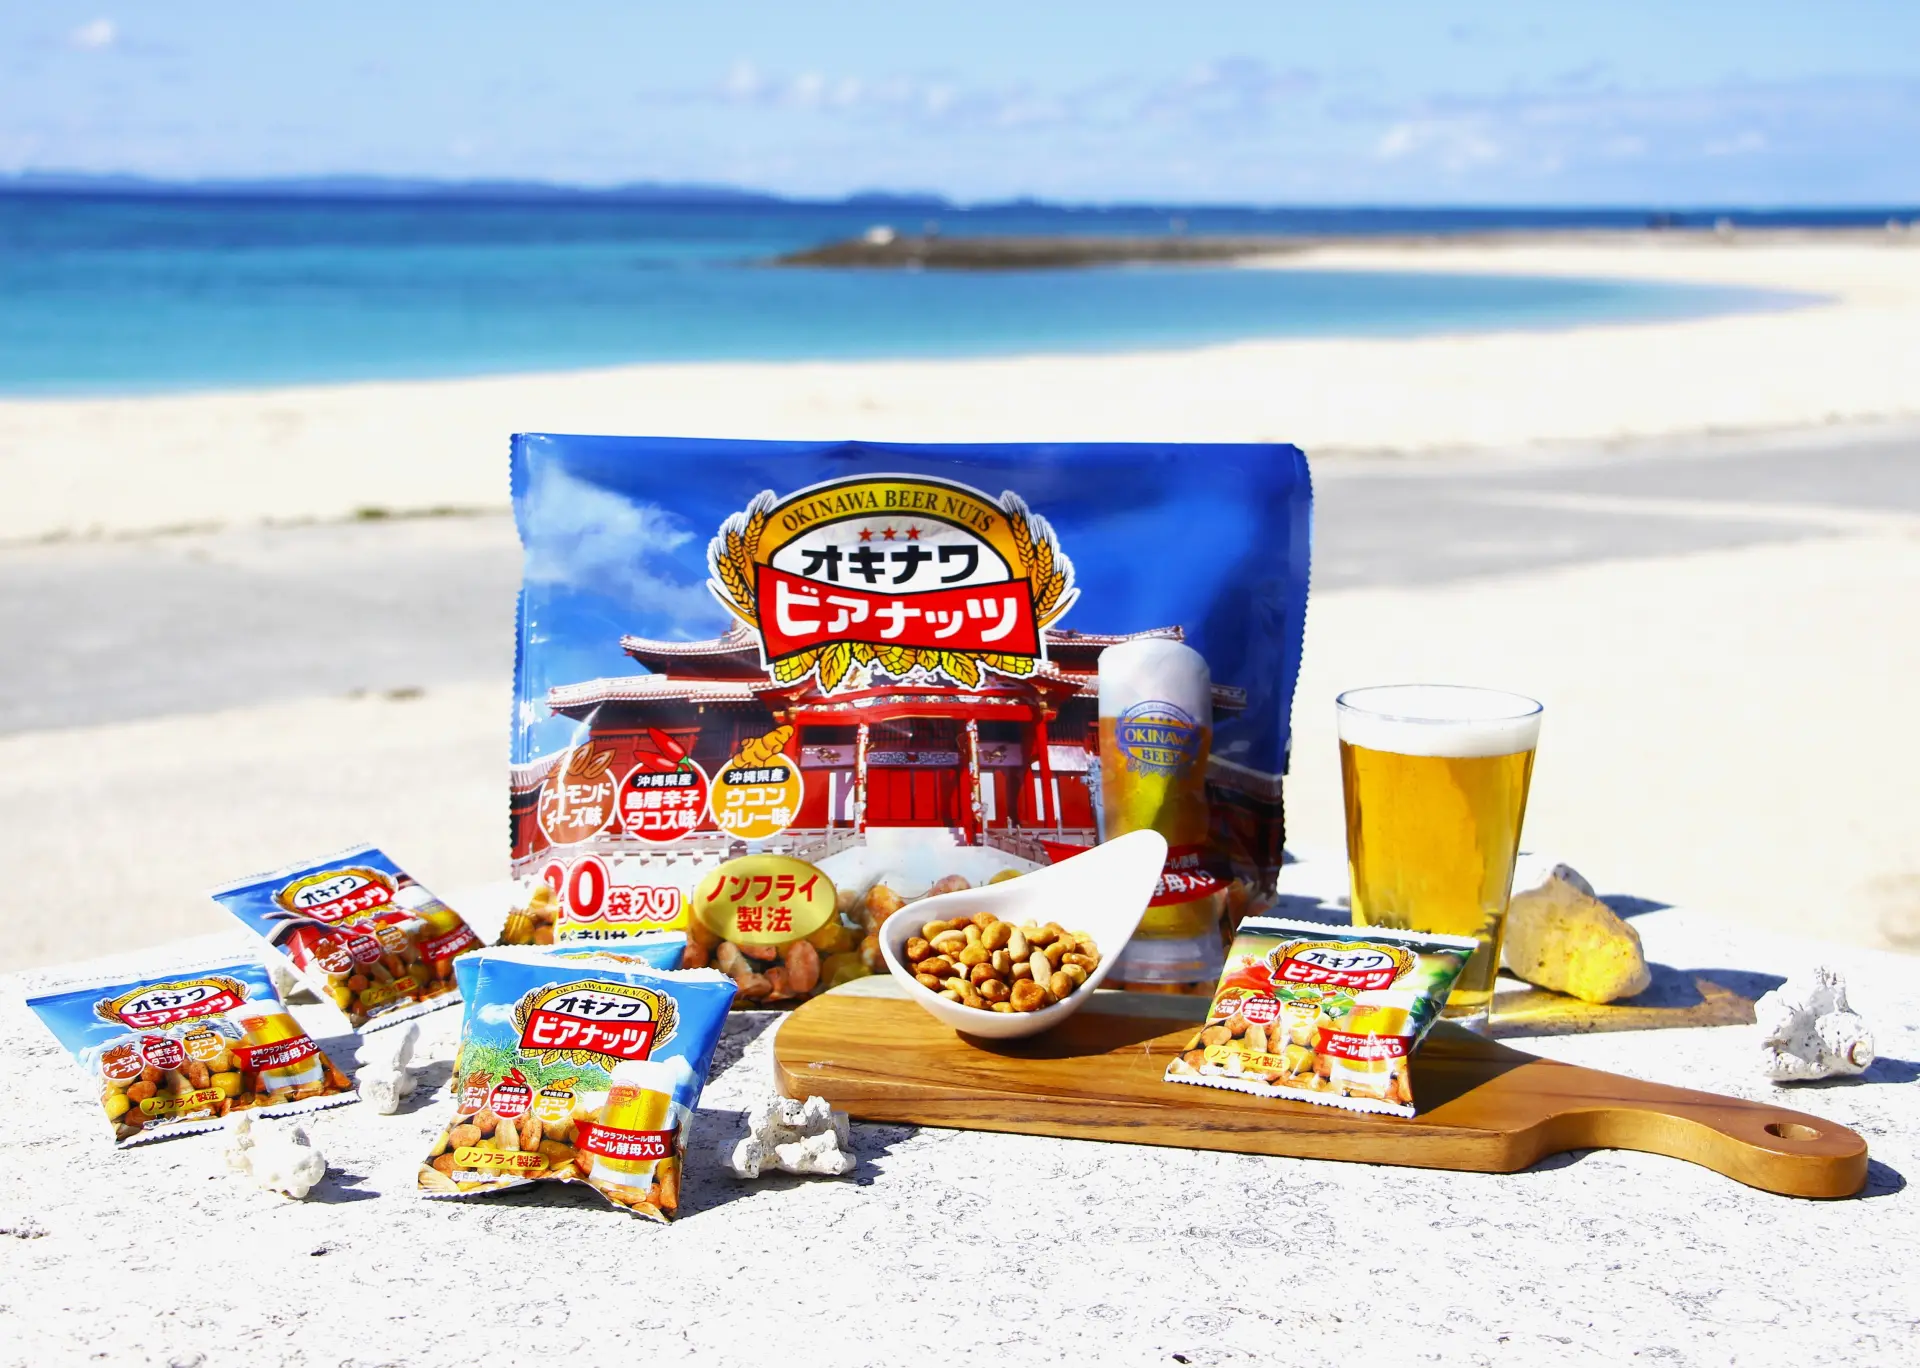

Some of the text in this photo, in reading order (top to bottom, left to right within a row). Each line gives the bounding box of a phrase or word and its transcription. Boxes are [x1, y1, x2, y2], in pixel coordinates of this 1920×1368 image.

[782, 489, 996, 533] OKINAWA BEER NUTS
[801, 544, 979, 584] オキナワ
[775, 580, 1018, 643] ビアナッツ
[636, 773, 693, 787] 沖縄県産
[728, 767, 785, 784] 沖縄県産
[624, 789, 701, 810] 島唐辛子
[725, 788, 786, 807] ウコン
[625, 809, 698, 831] タコス味
[718, 807, 791, 829] カレー味
[706, 873, 821, 902] ノンフライ
[735, 906, 793, 933] 製法
[1306, 952, 1385, 969] オキナワ
[1283, 963, 1391, 989] ビアナッツ
[556, 982, 602, 995] OKINAWA
[128, 995, 234, 1026] ビアナッツ
[131, 987, 206, 1013] オキナワ
[555, 996, 641, 1018] オキナワ
[530, 1015, 648, 1055] ビアナッツ
[587, 1135, 666, 1157] ビール酵母入り
[460, 1151, 542, 1168] ノンフライ製法
